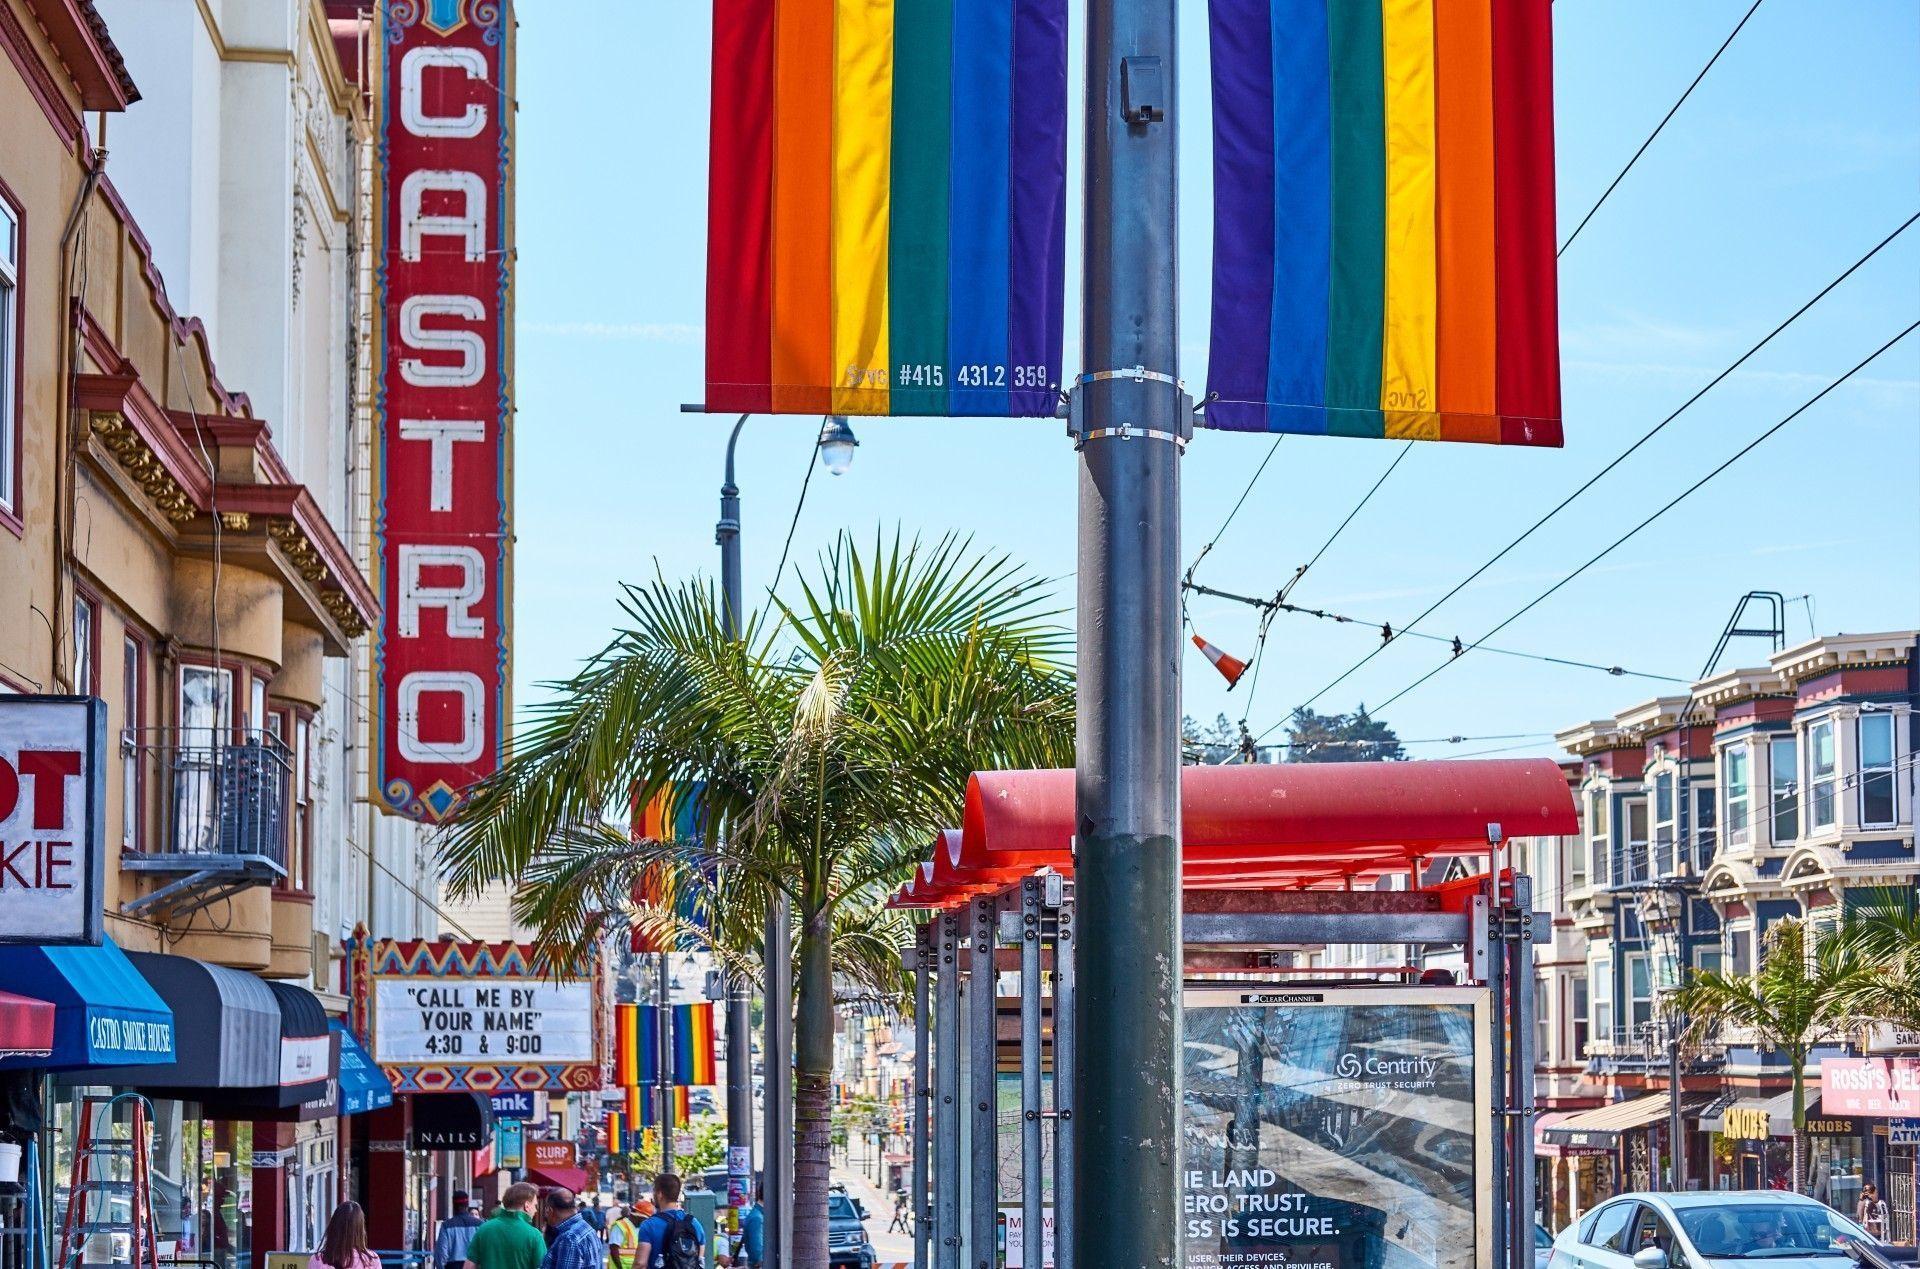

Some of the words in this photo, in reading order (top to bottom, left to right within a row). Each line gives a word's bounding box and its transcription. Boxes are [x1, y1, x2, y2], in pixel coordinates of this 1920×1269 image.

[899, 364, 943, 387] #415
[957, 365, 1006, 387] 431.2
[1014, 365, 1047, 387] 359
[397, 44, 491, 764] CASTRO
[0, 750, 81, 830] T
[476, 988, 500, 1008] ME
[511, 988, 535, 1008] BY
[421, 1011, 473, 1031] YOUR
[90, 1016, 121, 1050] CASTRO
[122, 1020, 147, 1051] SMOKE
[147, 1022, 171, 1052] HOUSE
[425, 1034, 462, 1054] 4:30
[479, 1034, 489, 1054] &
[506, 1034, 542, 1054] 9:00
[1365, 1056, 1436, 1078] Centrify
[1337, 1082, 1361, 1090] ZERO
[1394, 1081, 1436, 1089] SECURITY
[1724, 1107, 1769, 1140] KNOBS
[1807, 1120, 1852, 1133] KNOBS
[421, 1132, 477, 1143] NAILS
[536, 1146, 569, 1159] SLURP
[1212, 1170, 1276, 1187] LAND
[1236, 1194, 1309, 1213] TRUST,
[1221, 1219, 1240, 1237] IS
[1247, 1217, 1340, 1236] SECURE.
[1188, 1254, 1215, 1263] USER,
[1217, 1254, 1243, 1262] THEIR
[1246, 1253, 1287, 1262] DEVICES,
